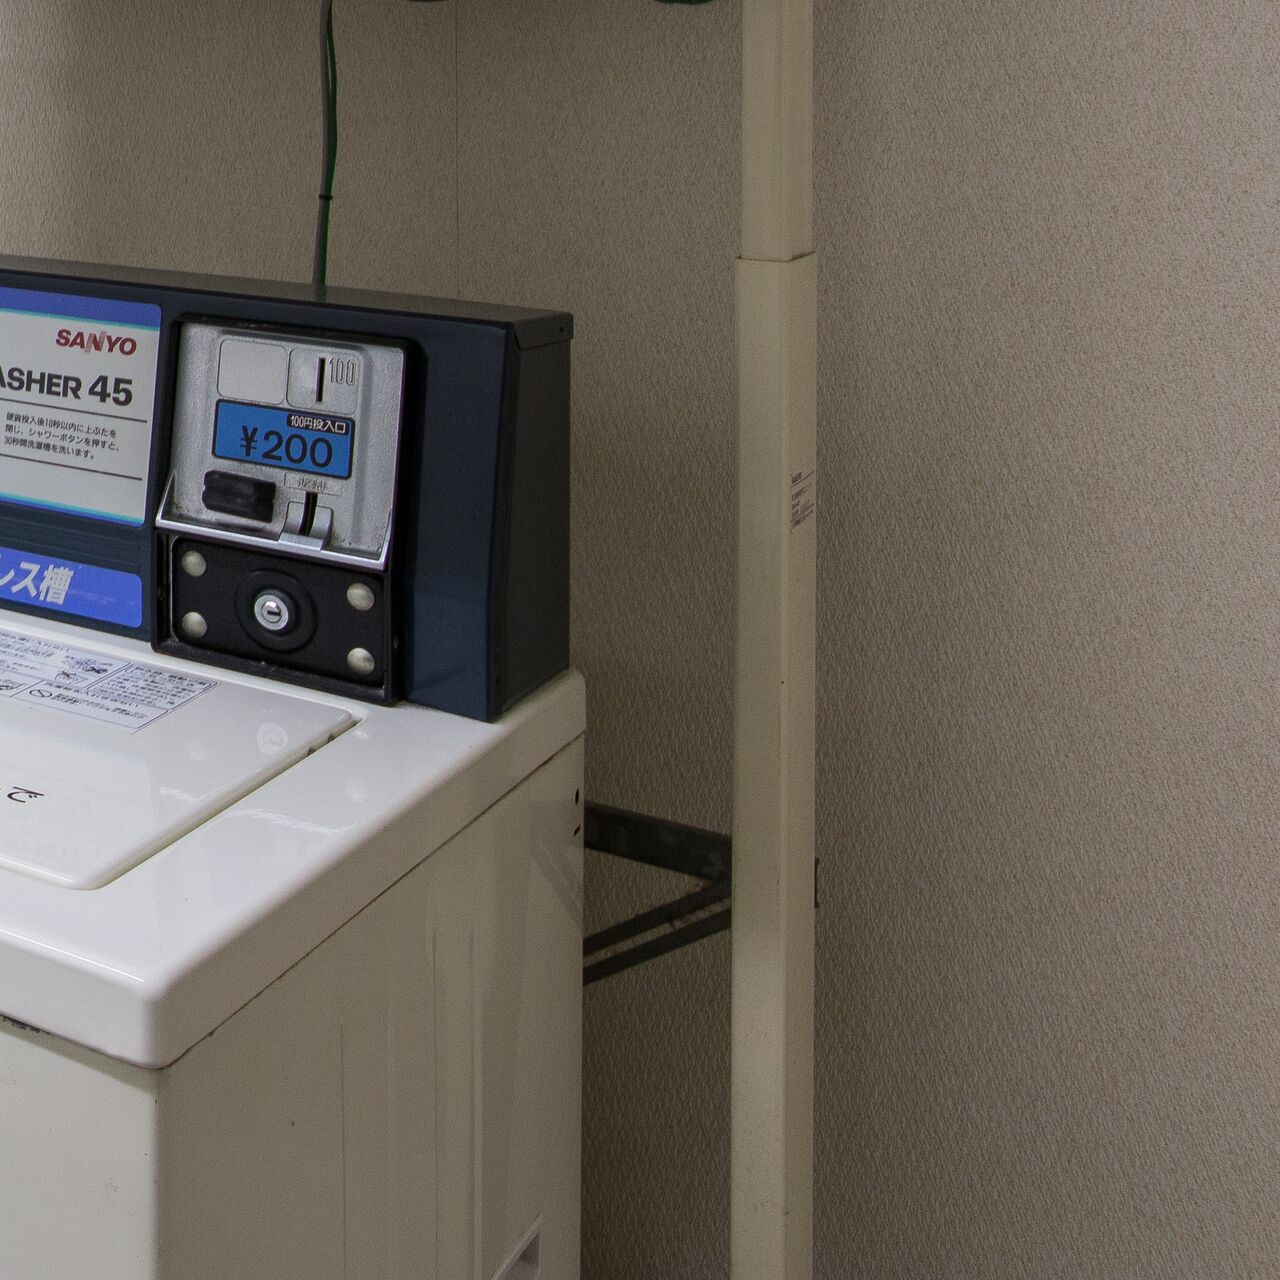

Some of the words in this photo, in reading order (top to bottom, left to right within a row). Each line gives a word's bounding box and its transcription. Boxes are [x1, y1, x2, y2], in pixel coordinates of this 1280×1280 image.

[55, 328, 137, 356] SANYO
[329, 357, 356, 386] 100
[89, 375, 133, 407] 45
[5, 424, 120, 453] 閉じ、シャワーボタンを押すと、
[6, 411, 117, 439] 硬貨投入後10秒以内に上ぶたを
[290, 415, 346, 434] 100円投入口
[4, 435, 96, 460] 30秒間洗濯槽を洗います。
[240, 424, 333, 468] ¥200
